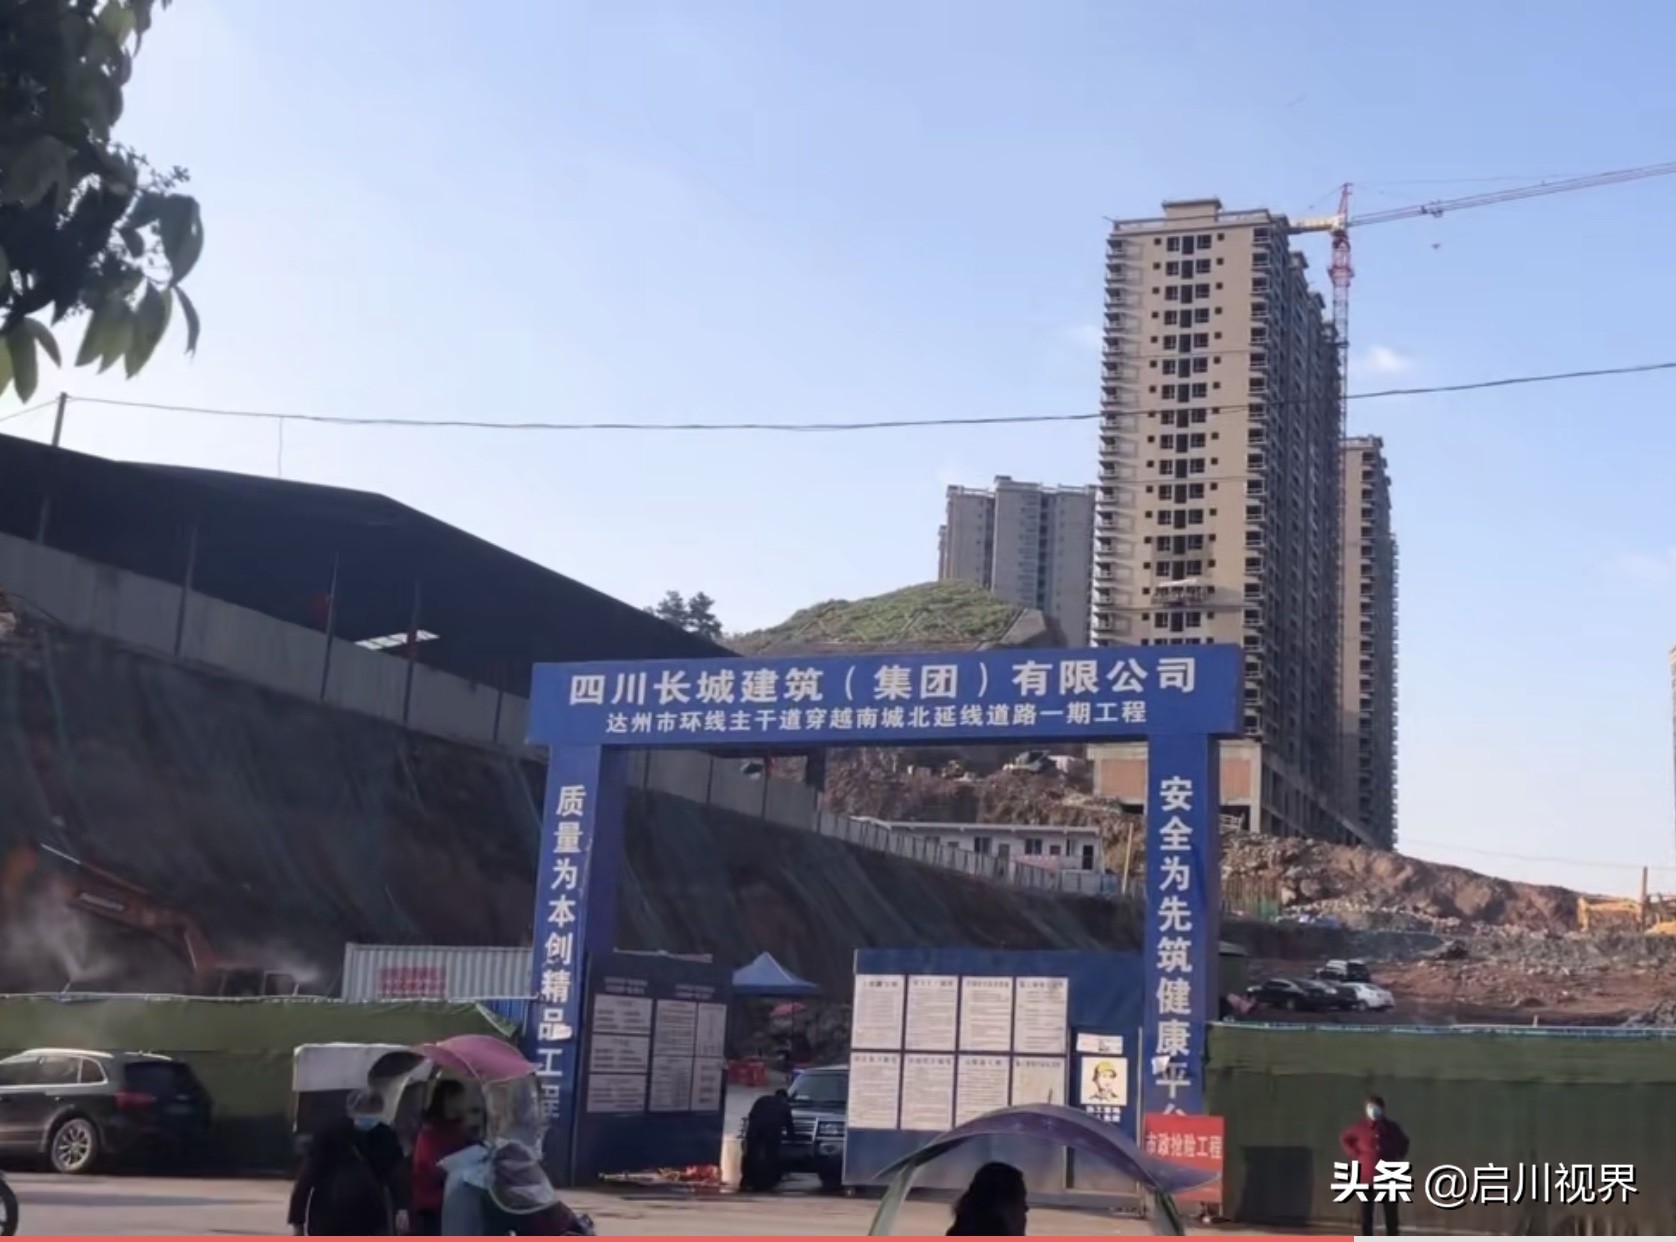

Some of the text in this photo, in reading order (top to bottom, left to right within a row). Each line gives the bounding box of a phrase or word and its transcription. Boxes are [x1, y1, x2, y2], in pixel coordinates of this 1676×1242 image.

[605, 700, 1147, 734] 达州市环线主干道穿越南城北延线道路一期工程
[1156, 776, 1193, 1115] 安全为先筑健康平
